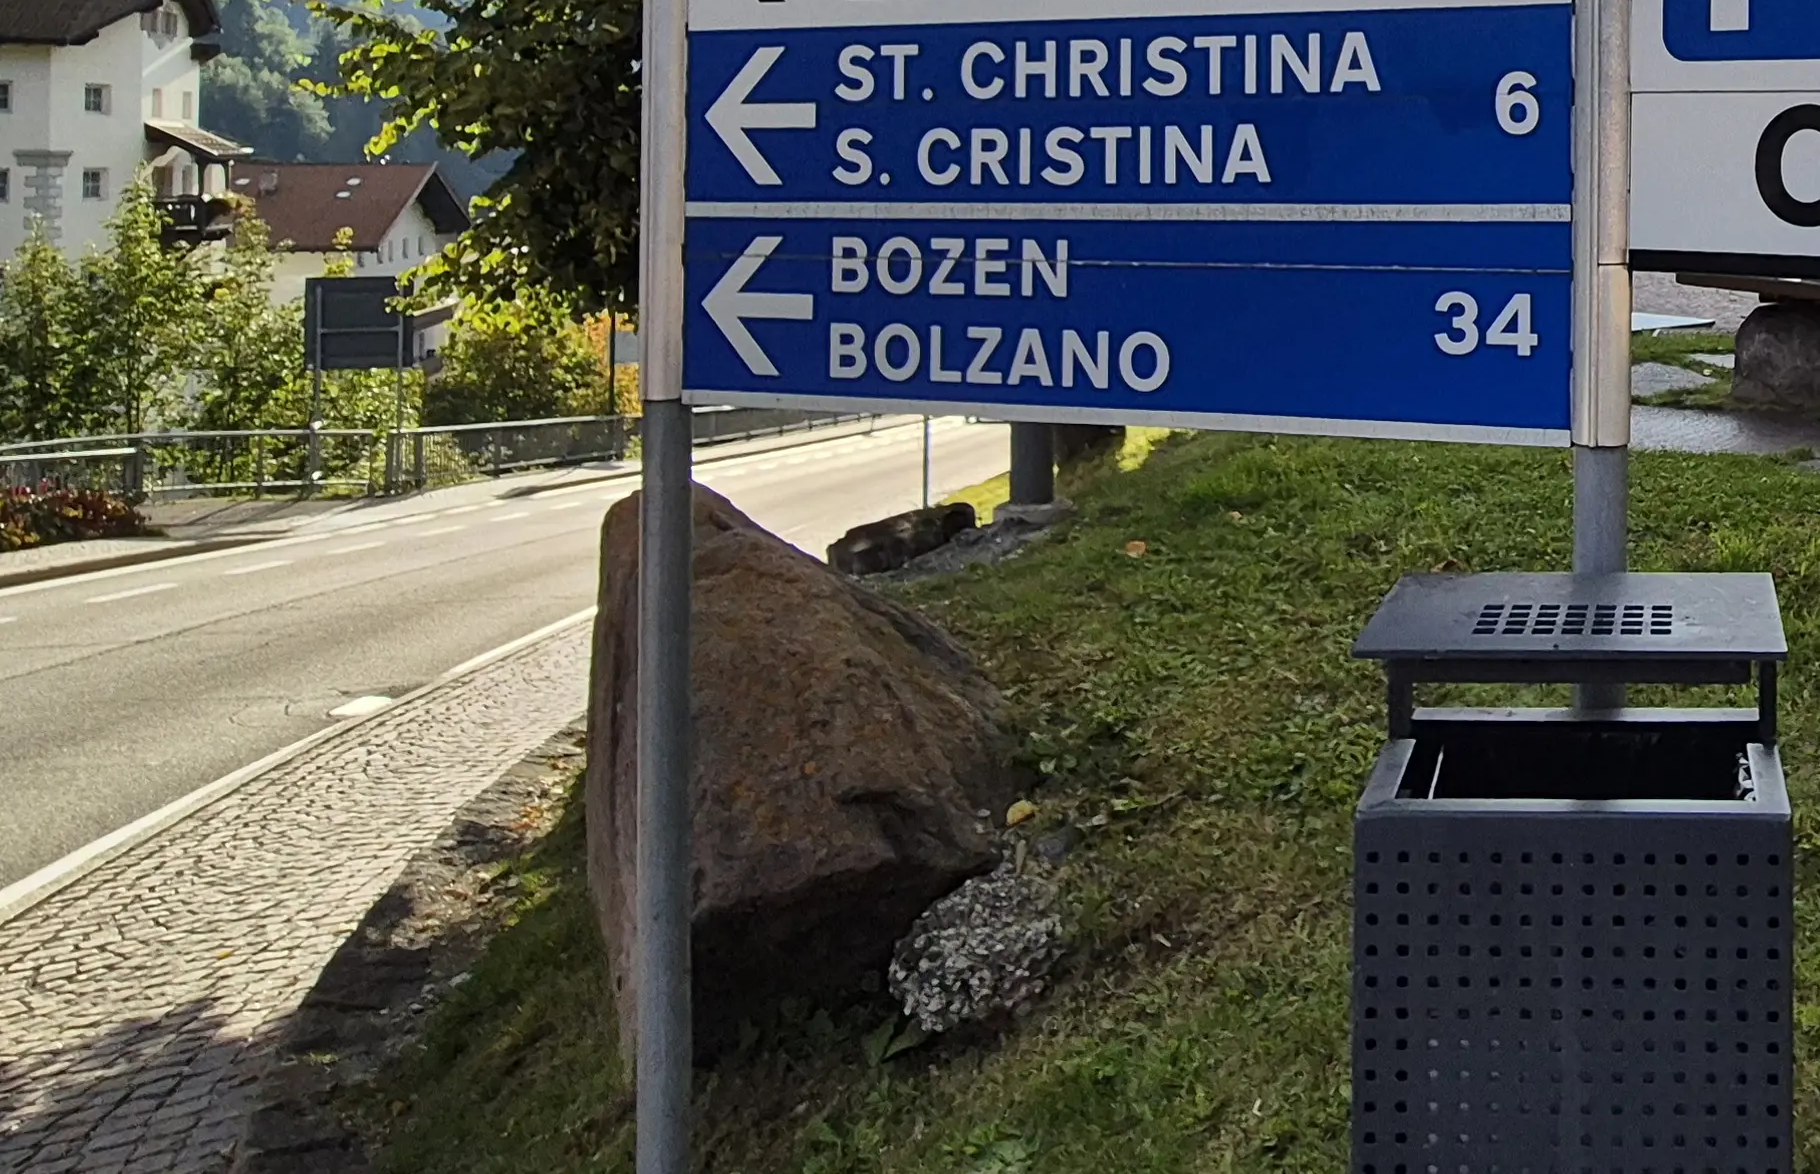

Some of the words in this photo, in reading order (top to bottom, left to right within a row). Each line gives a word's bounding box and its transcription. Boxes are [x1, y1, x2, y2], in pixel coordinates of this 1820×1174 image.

[835, 44, 933, 101] ST.
[961, 32, 1381, 99] CHRISTINA
[1496, 71, 1539, 134] 6
[833, 128, 890, 185] S.
[918, 124, 1271, 185] CRISTINA
[832, 237, 1067, 297] BOZEN
[1434, 291, 1538, 356] 34
[830, 323, 1169, 392] BOLZANO
